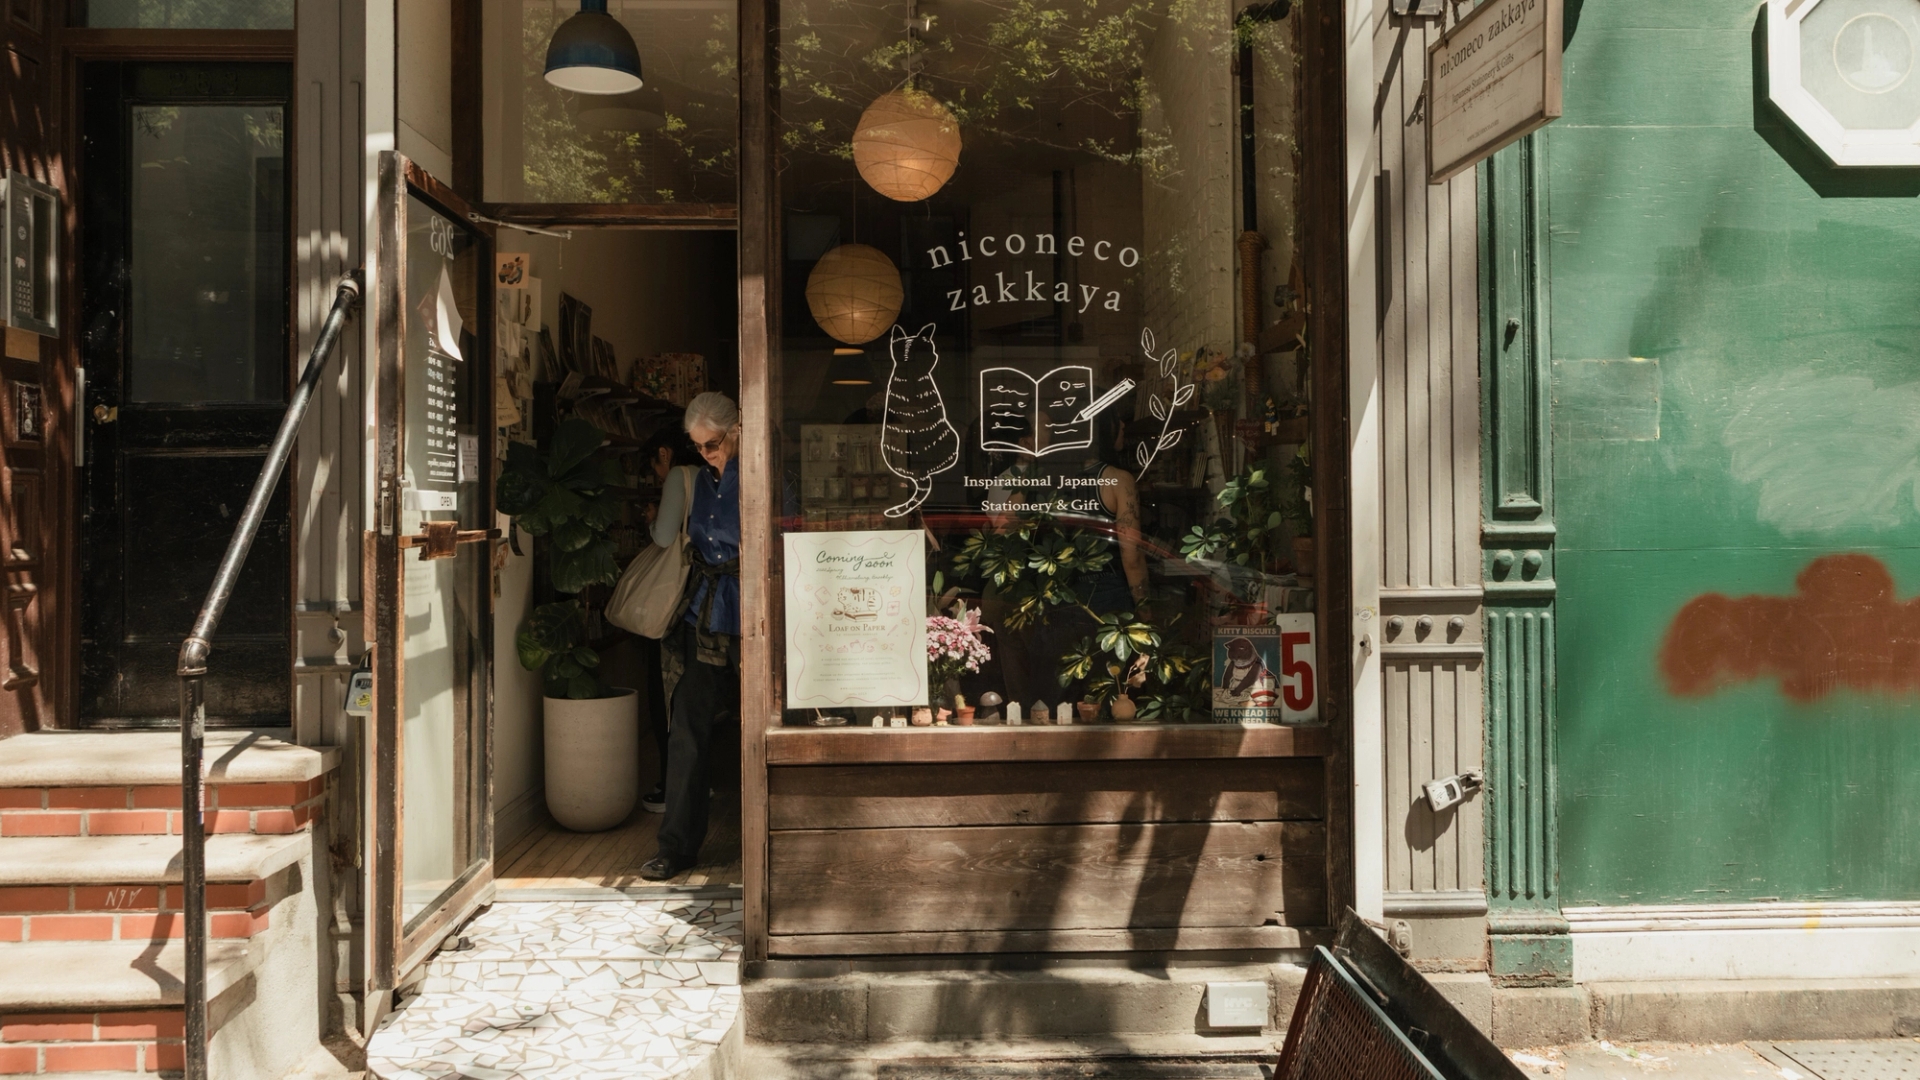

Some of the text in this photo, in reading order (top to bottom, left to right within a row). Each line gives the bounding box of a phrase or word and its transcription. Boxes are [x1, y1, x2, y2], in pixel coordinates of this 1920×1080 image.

[1488, 0, 1535, 41] zakkaya
[927, 231, 1139, 269] niconeco
[947, 270, 1121, 314] zakkaya
[964, 475, 1118, 490] Inspirational Japanese
[981, 499, 1099, 513] Stationery & Gift
[816, 550, 894, 571] Coming soon
[1281, 632, 1314, 712] 5
[1214, 709, 1279, 717] WE KNEAD EM
